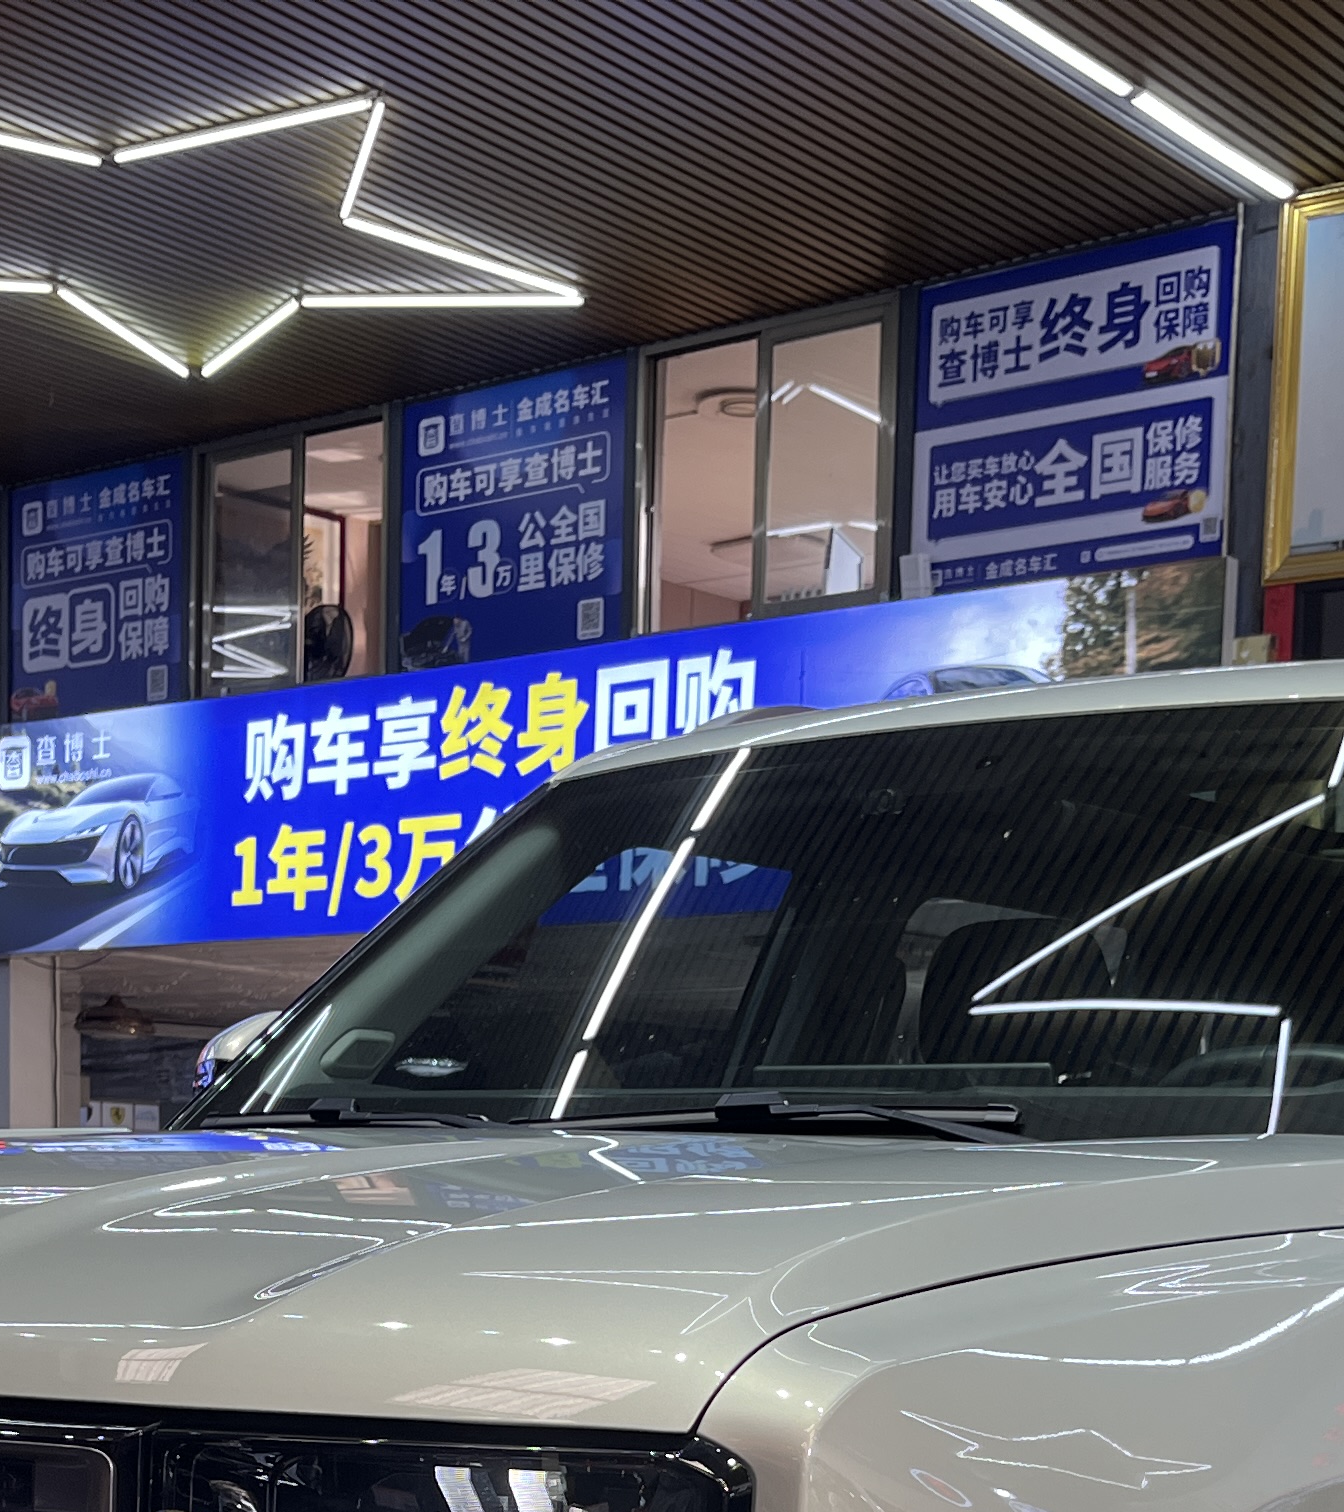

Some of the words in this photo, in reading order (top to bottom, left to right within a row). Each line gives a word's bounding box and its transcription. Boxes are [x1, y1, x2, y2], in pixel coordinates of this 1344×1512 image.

[1156, 266, 1211, 307] 回购
[939, 300, 1034, 345] 购车可享
[1039, 281, 1150, 364] 终身
[1154, 302, 1209, 343] 保障
[938, 335, 1033, 387] 查博士
[517, 379, 609, 422] 金成名车汇
[1146, 415, 1202, 456] 保修
[424, 441, 603, 507] 购车可享查博士
[1034, 426, 1144, 507] 全国
[1144, 452, 1200, 490] 服务
[933, 475, 1033, 519] 用车安心
[27, 527, 166, 581] 购车可享查博士
[119, 573, 170, 619] 回购
[29, 598, 107, 661] 终身
[118, 616, 169, 661] 保障
[244, 646, 757, 803] 购车享终身回购
[36, 730, 112, 766] 查博士
